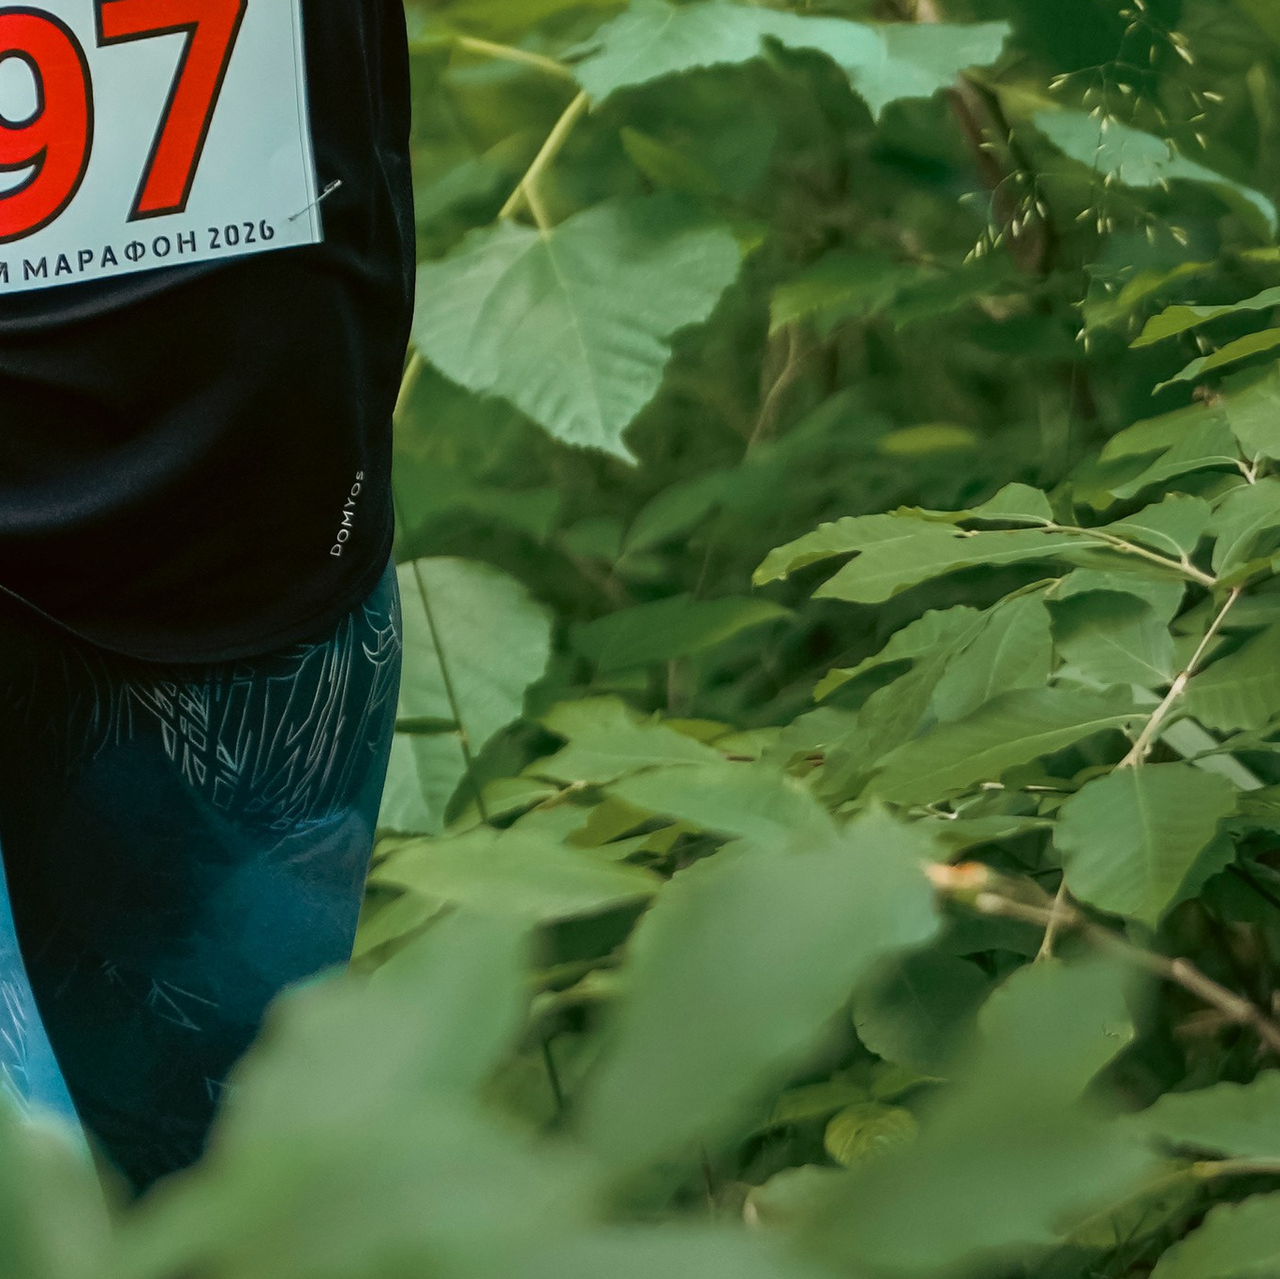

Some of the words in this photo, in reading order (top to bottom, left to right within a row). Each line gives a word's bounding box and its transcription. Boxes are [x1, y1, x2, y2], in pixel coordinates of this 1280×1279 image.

[22, 229, 198, 282] МАРАФОН
[207, 219, 275, 250] 2026
[329, 470, 364, 557] DOMYOS
